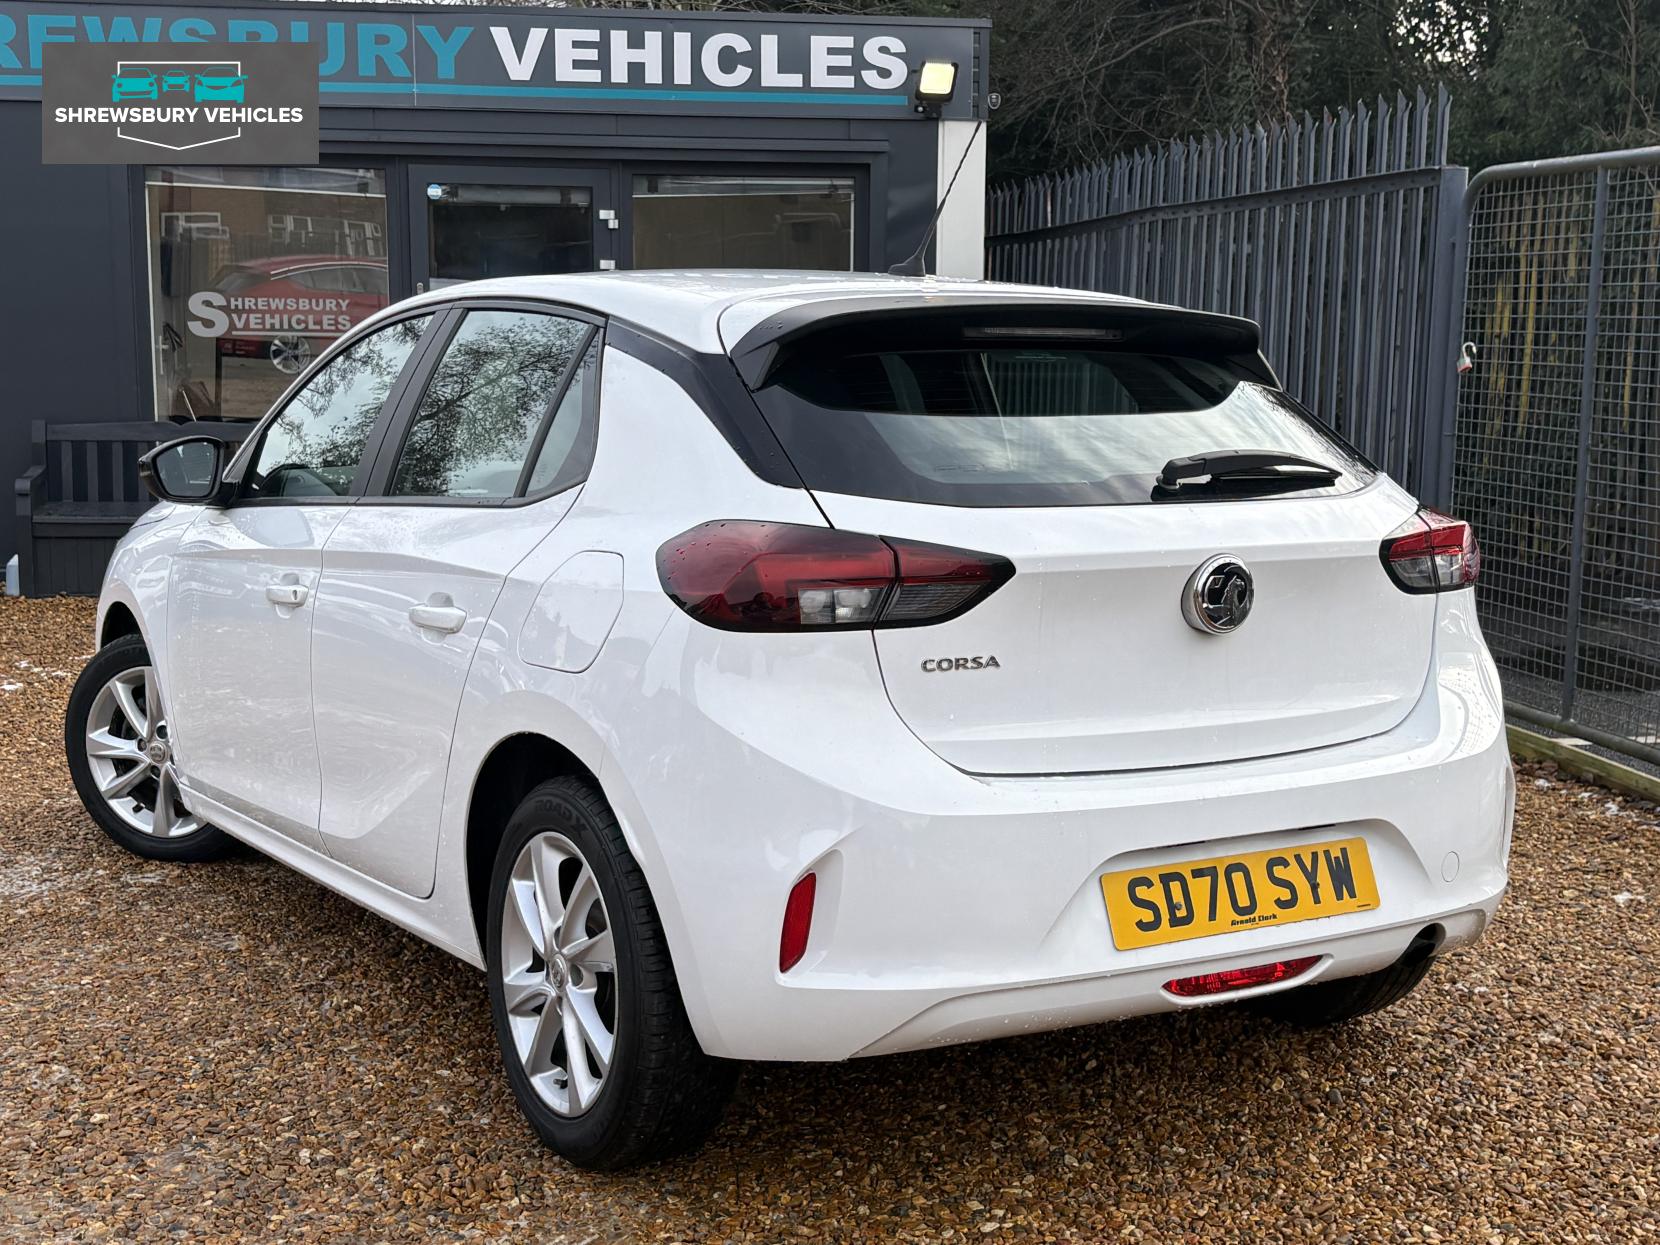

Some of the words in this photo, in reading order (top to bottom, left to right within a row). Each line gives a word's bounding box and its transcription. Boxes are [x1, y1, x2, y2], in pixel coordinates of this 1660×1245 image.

[489, 26, 908, 90] VEHICLES
[232, 314, 351, 329] VEHICLES
[921, 655, 1001, 673] CORSA
[1127, 862, 1258, 933] SD70
[1265, 847, 1358, 911] SYW
[1231, 916, 1256, 926] Arnold
